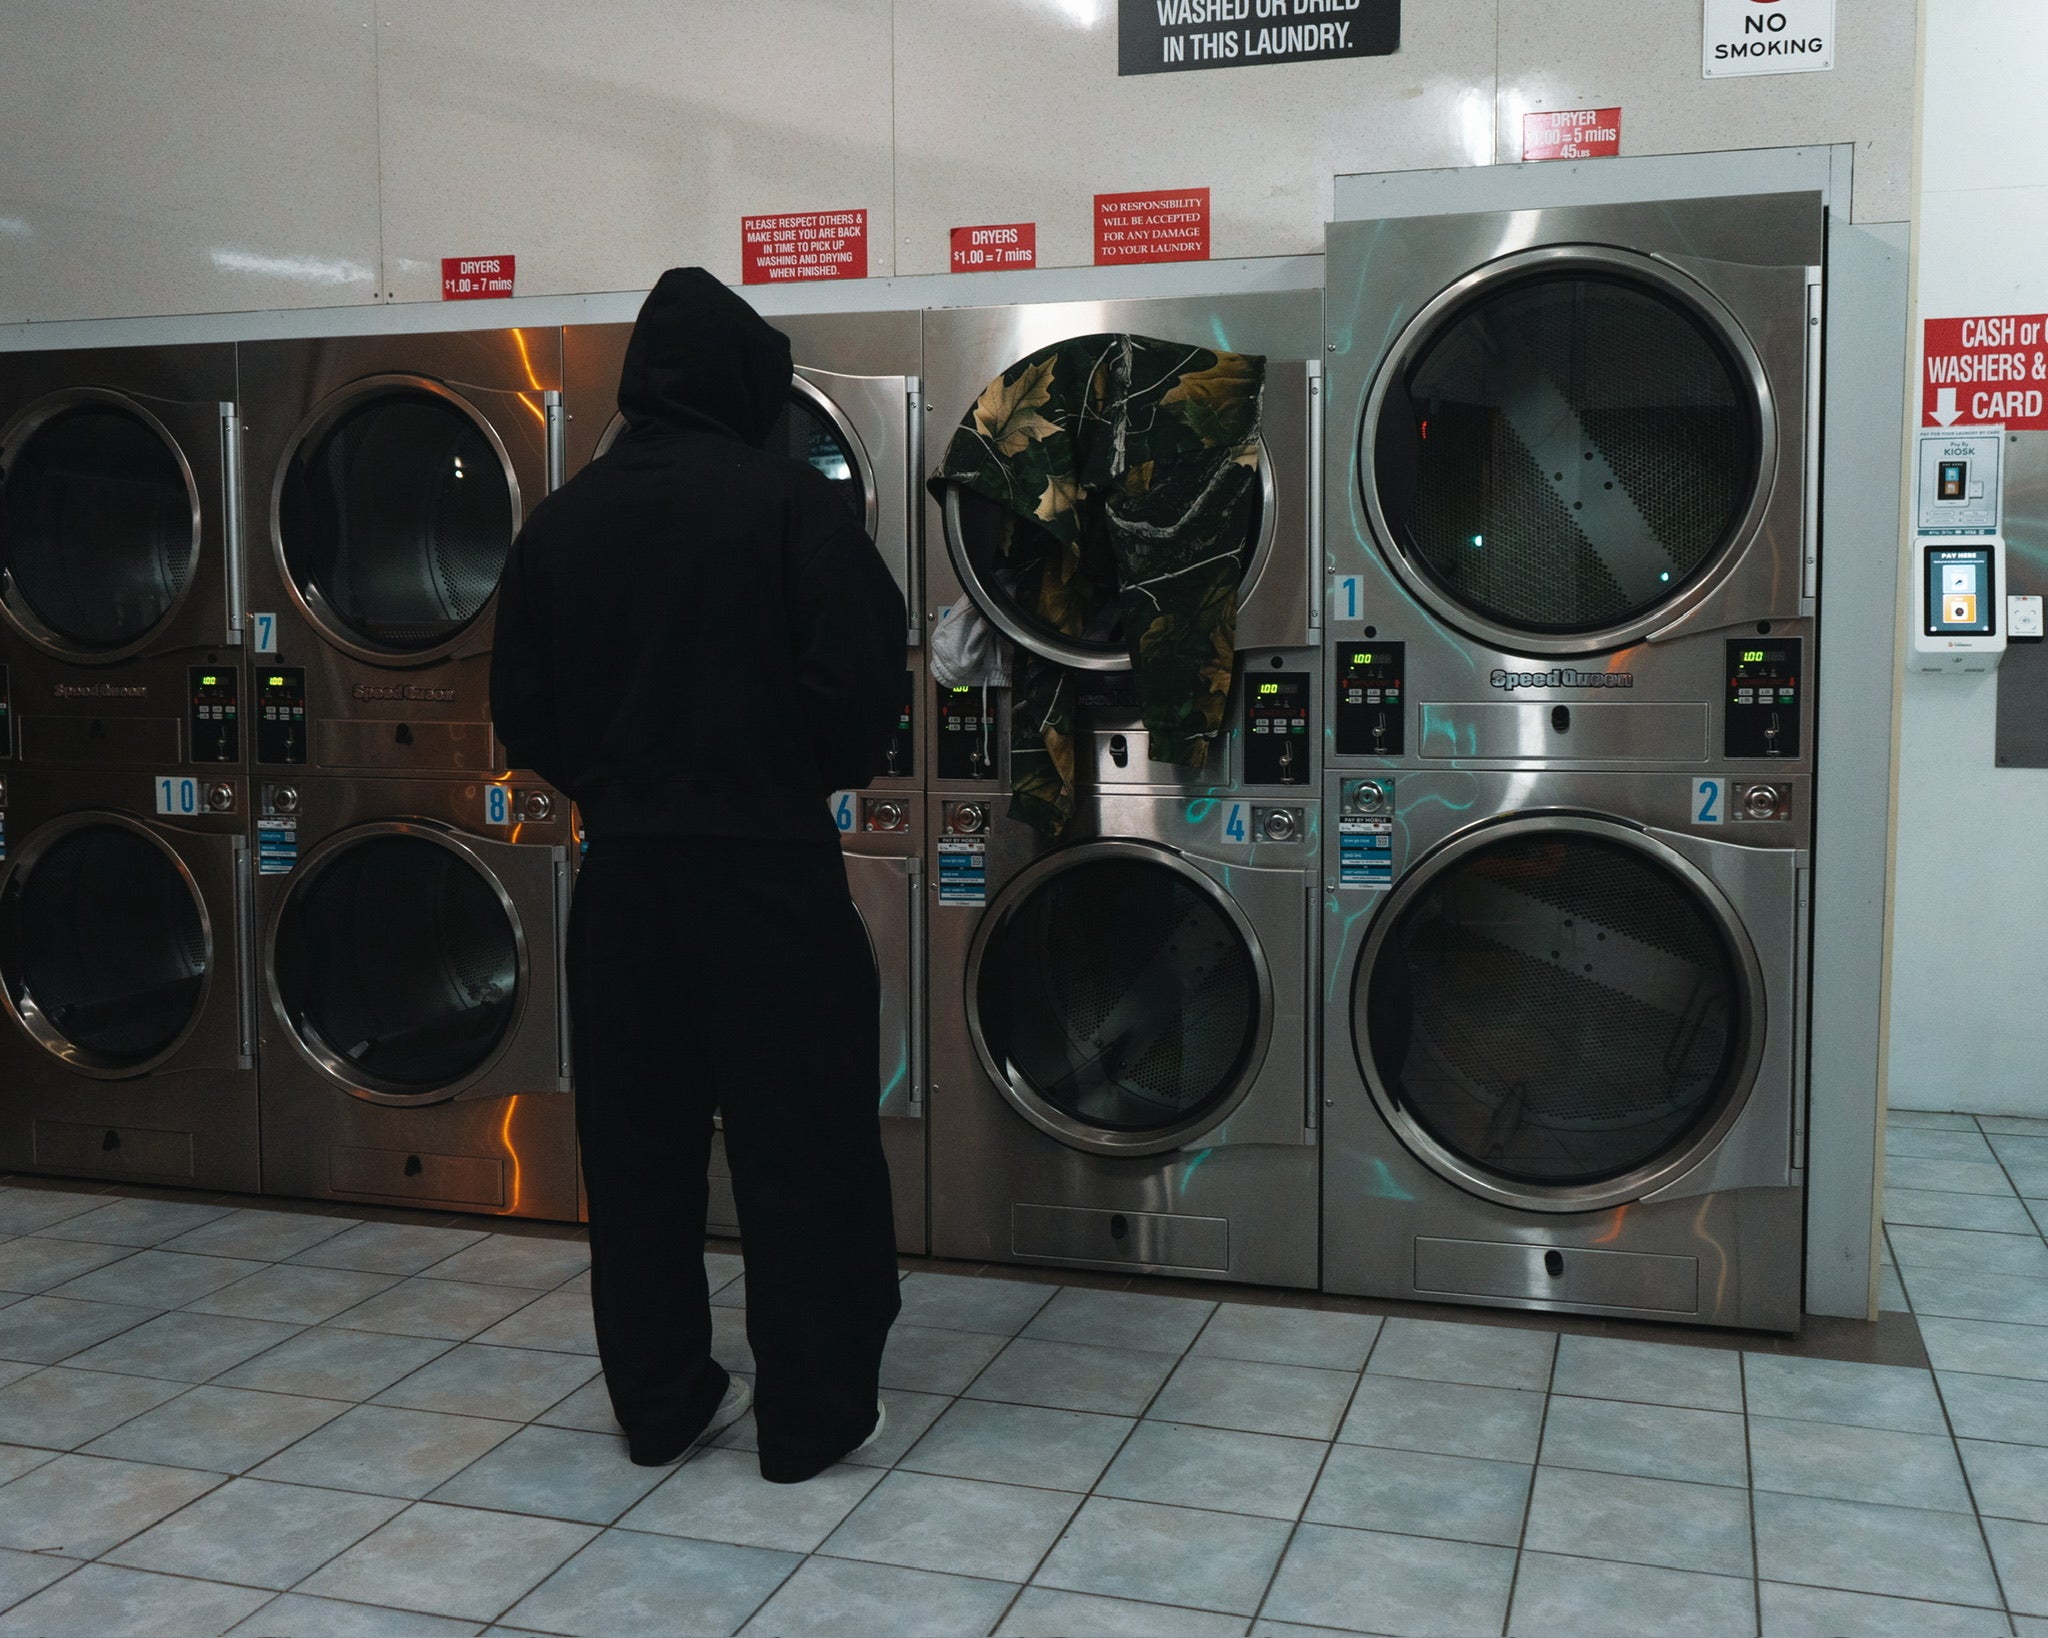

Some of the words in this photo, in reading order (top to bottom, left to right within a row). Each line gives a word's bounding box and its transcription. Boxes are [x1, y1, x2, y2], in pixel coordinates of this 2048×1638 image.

[1157, 0, 1250, 26] WASHED
[1256, 0, 1287, 18] OR
[1745, 13, 1787, 34] NO
[1163, 35, 1184, 63] IN
[1189, 31, 1239, 60] THIS
[1245, 21, 1353, 56] LAUNDRY.
[1715, 38, 1823, 59] SMOKING
[1551, 110, 1597, 128] DRYER
[1573, 127, 1582, 143] 5
[1585, 126, 1617, 143] mins
[1101, 203, 1118, 213] NO
[1120, 198, 1203, 212] RESPONSIBILITY
[745, 218, 777, 230] PLEASE
[779, 216, 817, 228] RESPECT
[819, 213, 853, 226] OTHERS
[857, 213, 863, 223] &
[1103, 218, 1128, 227] WILL
[1131, 216, 1143, 225] BE
[1145, 212, 1201, 224] ACCEPTED
[747, 231, 771, 243] MAKE
[773, 229, 796, 241] SURE
[798, 228, 817, 240] YOU
[818, 227, 835, 239] ARE
[838, 226, 861, 237] BACK
[971, 228, 1018, 245] DRYERS
[1103, 231, 1125, 241] FOR
[1126, 230, 1150, 240] ANY
[1152, 227, 1200, 239] DAMAGE
[763, 244, 772, 254] IN
[775, 243, 795, 254] TIME
[797, 242, 809, 252] TO
[810, 240, 831, 251] PICK
[832, 239, 845, 250] UP
[1101, 246, 1116, 256] TO
[1119, 245, 1148, 254] YOUR
[1150, 242, 1203, 253] LAUNDRY
[756, 255, 797, 267] WASHING
[799, 253, 818, 264] AND
[819, 252, 853, 263] DRYING
[954, 249, 984, 265] $1.00
[995, 248, 1002, 263] 7
[1005, 247, 1032, 262] mins
[460, 260, 500, 274] DRYERS
[769, 267, 795, 278] WHEN
[797, 265, 840, 277] FINISHED.
[445, 278, 471, 293] $1.00
[480, 278, 487, 291] 7
[489, 277, 512, 291] mins
[1961, 318, 2015, 348] CASH
[2020, 322, 2040, 346] or
[1927, 352, 2026, 383] WASHERS
[2031, 351, 2047, 380] &
[1972, 390, 2043, 419] CARD
[1944, 447, 1976, 456] KIOSK
[1342, 578, 1356, 618] 1
[258, 617, 272, 650] 7
[1490, 669, 1561, 691] Speed
[1561, 669, 1633, 688] Queen
[162, 779, 194, 813] 10
[489, 787, 505, 823] 8
[1698, 780, 1719, 823] 2
[836, 794, 851, 831] 6
[1225, 803, 1246, 842] 4
